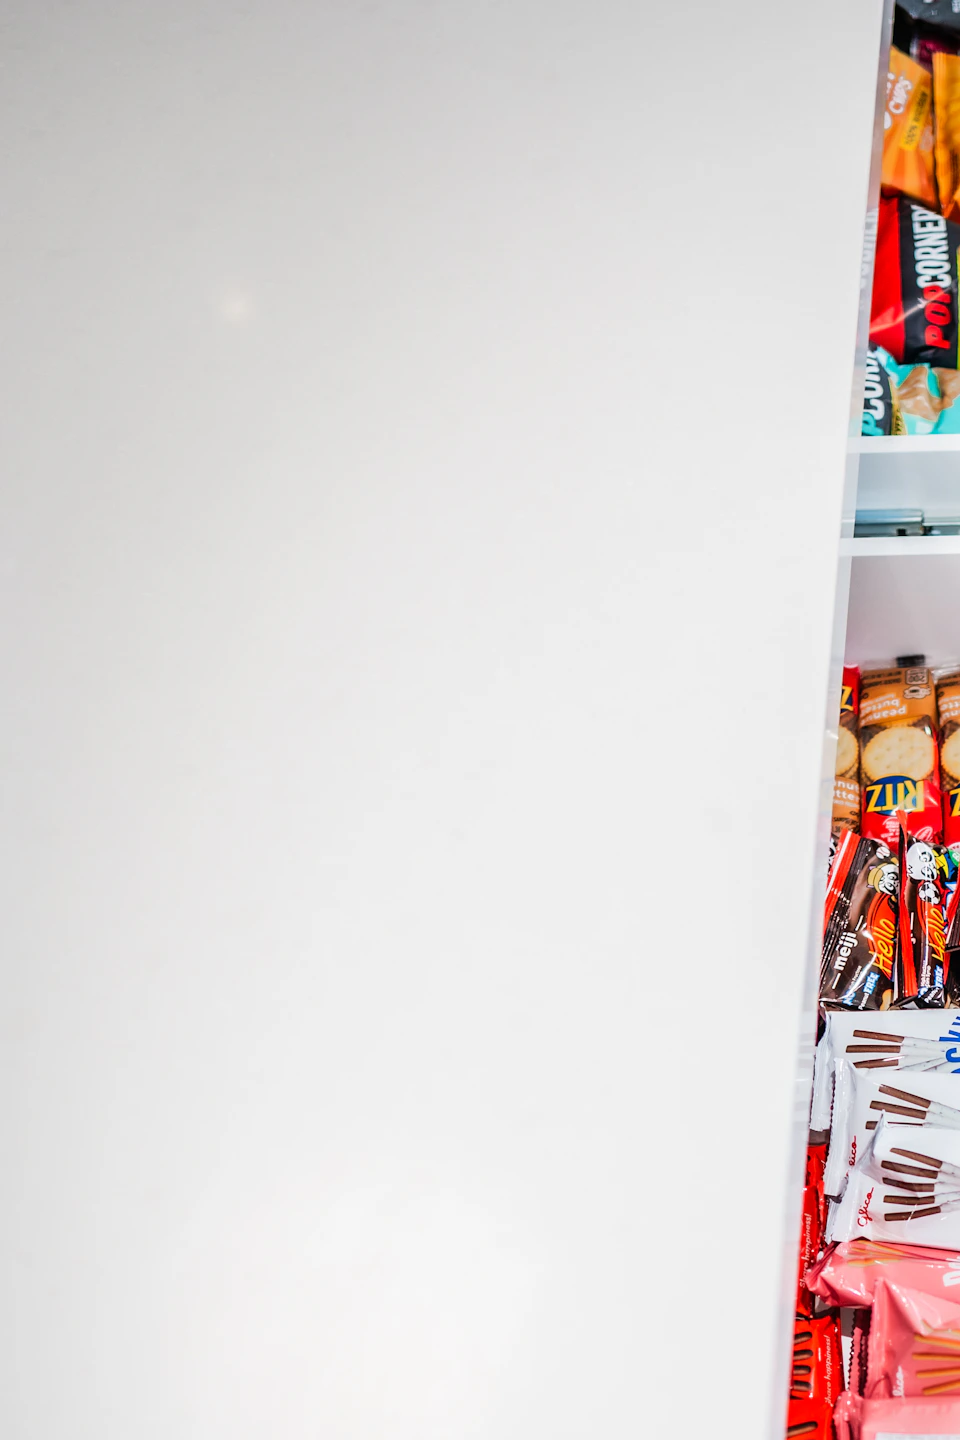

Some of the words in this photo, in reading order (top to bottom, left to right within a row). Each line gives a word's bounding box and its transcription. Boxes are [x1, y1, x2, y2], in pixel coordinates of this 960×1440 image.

[911, 205, 952, 349] POPCORNER
[866, 780, 925, 814] RITZ
[869, 918, 896, 974] Hello
[863, 972, 880, 994] FREE
[933, 964, 944, 988] FREE
[858, 992, 870, 1011] Peanut
[849, 1135, 858, 1166] lico
[857, 1186, 875, 1228] Glico
